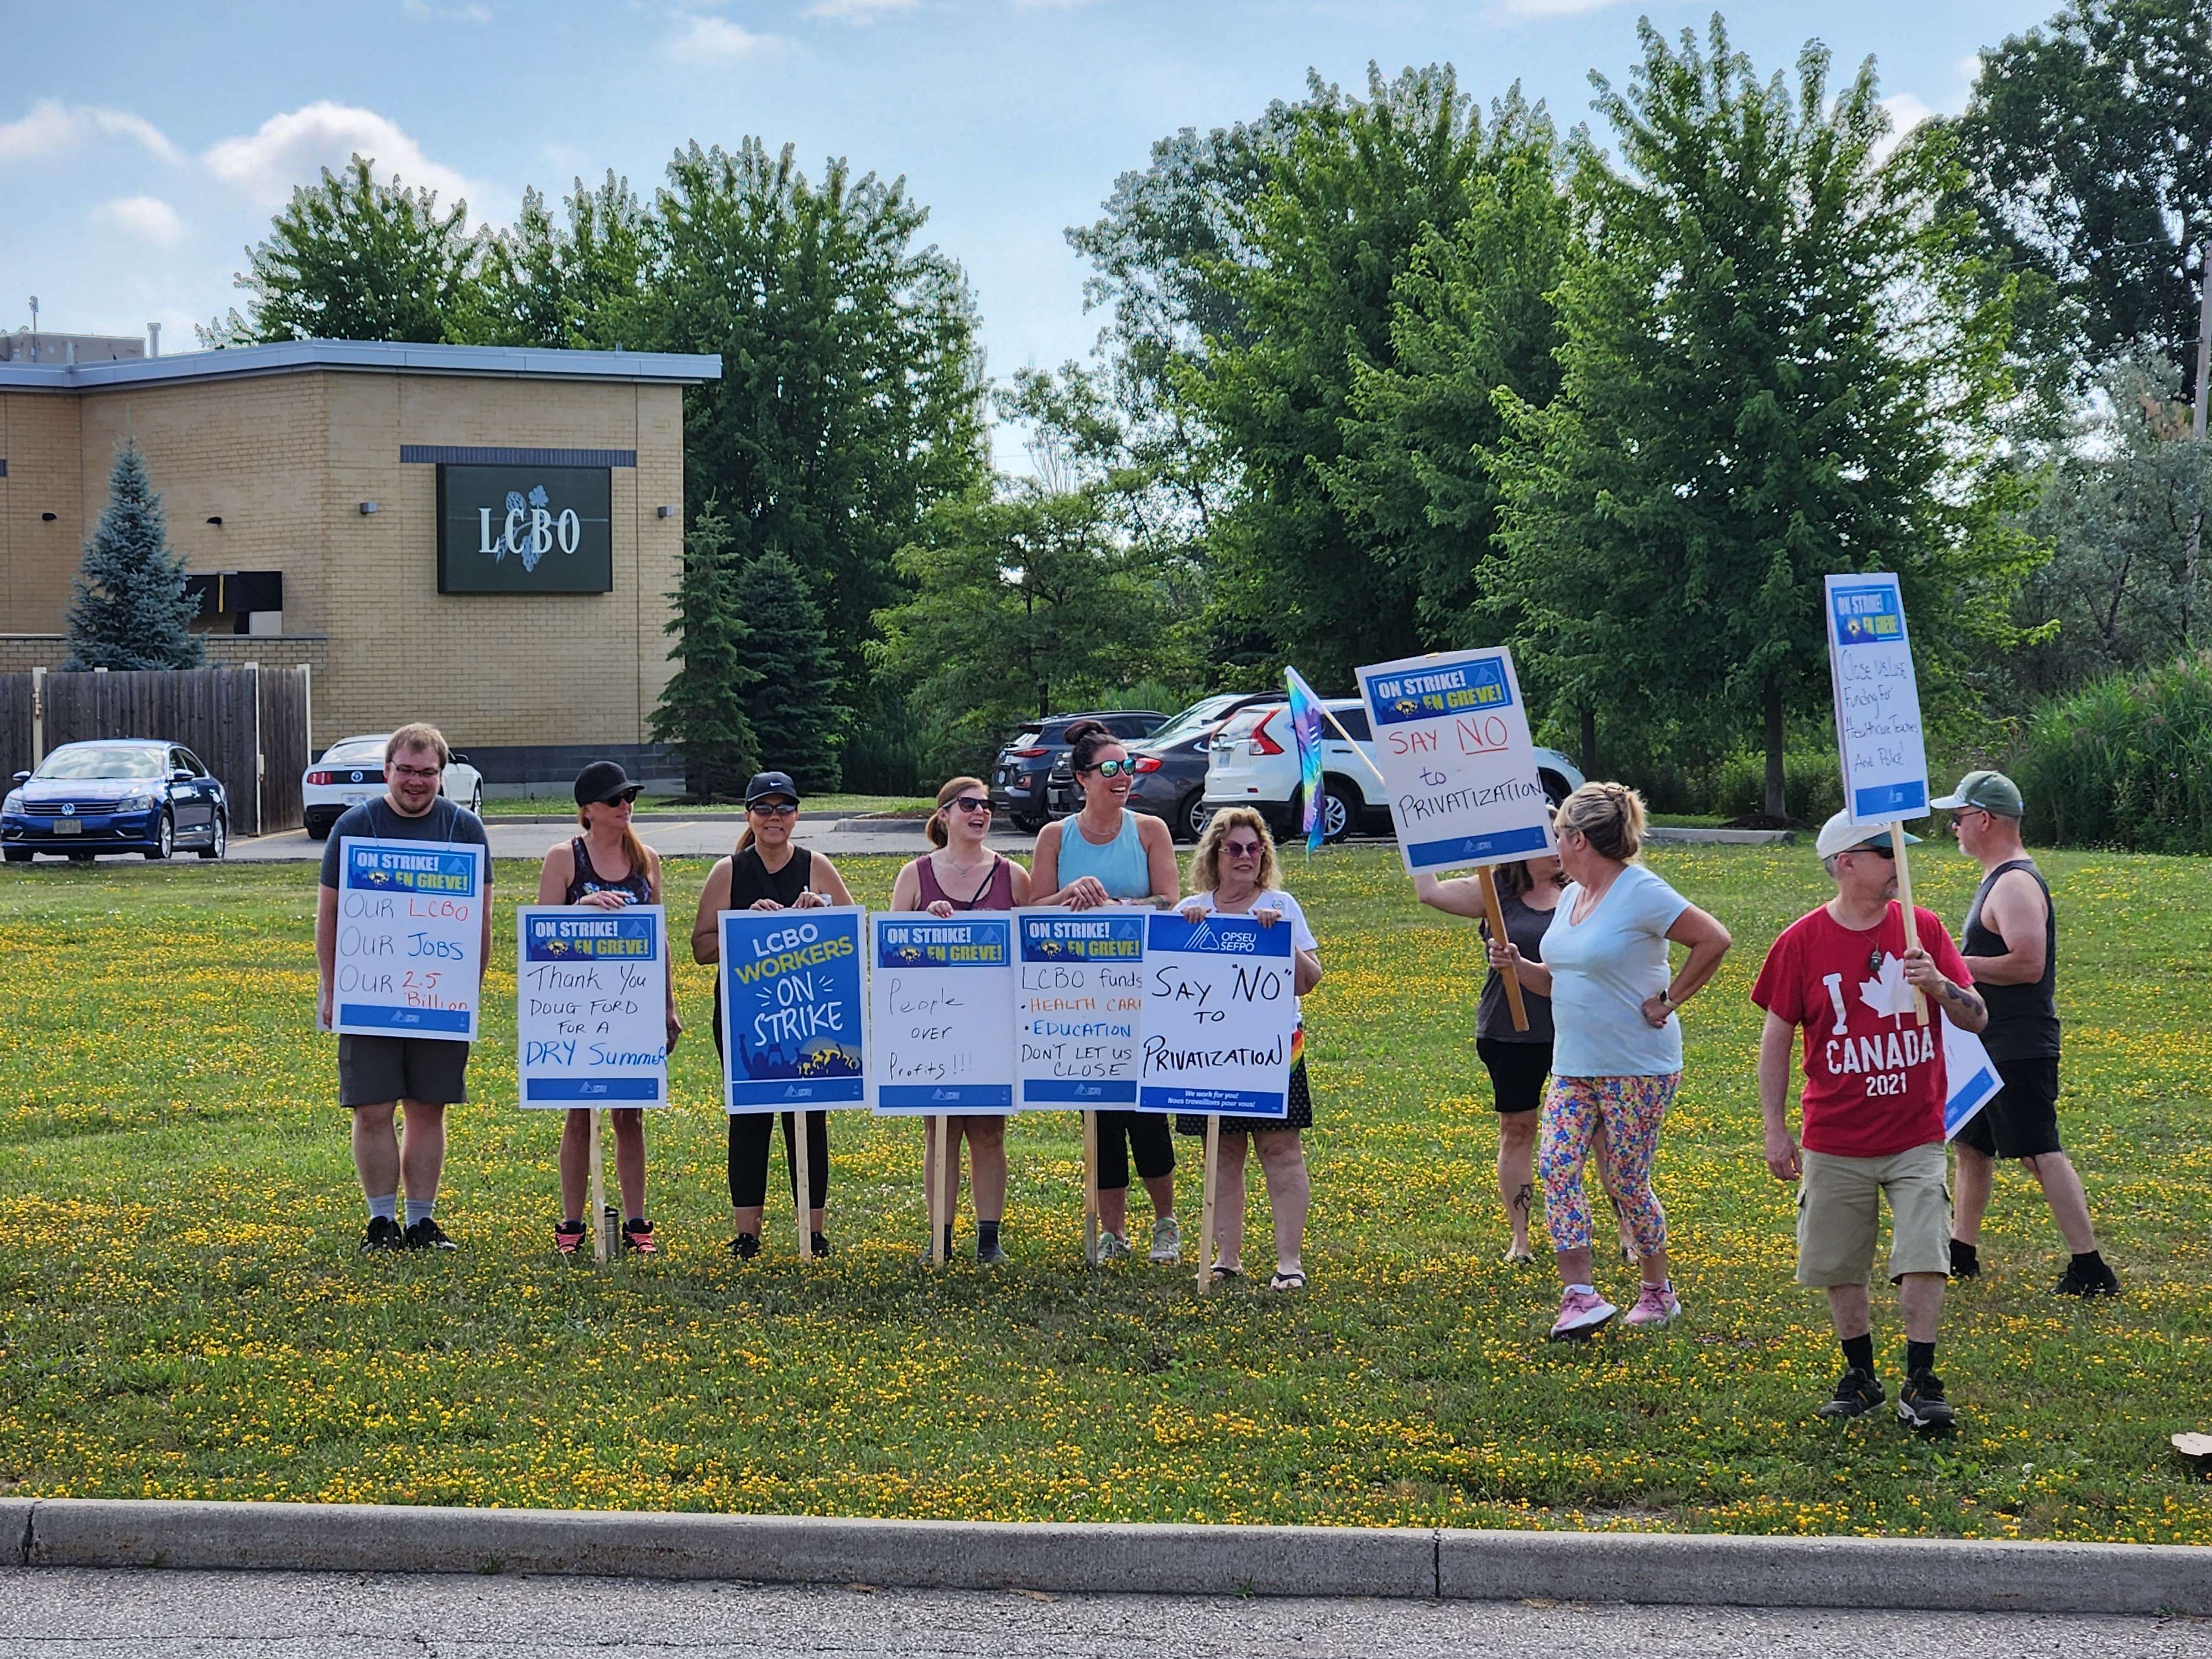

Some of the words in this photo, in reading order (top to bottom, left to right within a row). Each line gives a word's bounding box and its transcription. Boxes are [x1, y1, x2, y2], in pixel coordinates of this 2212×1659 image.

[478, 508, 581, 554] LCBO
[1378, 681, 1402, 699] ON
[1404, 670, 1466, 696] STRIKE!
[1422, 694, 1444, 711] EN
[1389, 728, 1437, 755] SAY
[1457, 716, 1508, 752] NO
[1420, 766, 1447, 786] to
[1399, 773, 1543, 828] PRIVATIZATION
[357, 852, 378, 868] ON
[382, 854, 440, 872] STRIKE!
[395, 872, 414, 887] EN
[344, 893, 394, 919] OUR
[409, 898, 469, 922] LCBO
[535, 922, 556, 938] ON
[560, 921, 618, 937] STRIKE!
[887, 928, 909, 944] ON
[912, 927, 971, 944] STRIKE!
[1029, 922, 1051, 938] ON
[1053, 921, 1110, 938] STRIKE!
[1221, 932, 1257, 943] OPSEU
[340, 925, 394, 957] OUR
[408, 932, 464, 960] JOBS
[574, 940, 592, 954] EN
[753, 923, 818, 958] LCBO
[1067, 941, 1086, 957] EN
[1220, 941, 1255, 952] SEFPO
[734, 936, 854, 985] WORKERS
[926, 946, 946, 961] EN
[339, 964, 393, 993] OUR
[402, 971, 442, 989] 2.5
[526, 964, 603, 992] Thank
[619, 963, 647, 995] You
[1021, 966, 1084, 990] LCBO
[1099, 968, 1142, 988] funds
[1151, 966, 1212, 1007] SAY
[777, 971, 815, 1007] ON
[890, 978, 964, 1016] People
[404, 991, 468, 1011] Billion
[530, 999, 583, 1017] DOUG
[590, 1000, 638, 1016] FORD
[1030, 997, 1095, 1013] HEALTH
[1822, 973, 1848, 1035] I
[754, 1001, 843, 1047] STRIKE
[1193, 1010, 1225, 1024] TO
[558, 1020, 586, 1035] FOR
[596, 1021, 609, 1035] A
[1033, 1019, 1131, 1037] EDUCATION
[526, 1039, 576, 1067] DRY
[1021, 1043, 1067, 1062] DON'T
[1076, 1045, 1107, 1060] LET
[1143, 1034, 1283, 1078] PRIVATIZATION
[1826, 1026, 1936, 1075] CANADA
[1053, 1062, 1128, 1077] CLOSE
[1213, 1091, 1224, 1099] for
[1865, 1072, 1907, 1098] 2021
